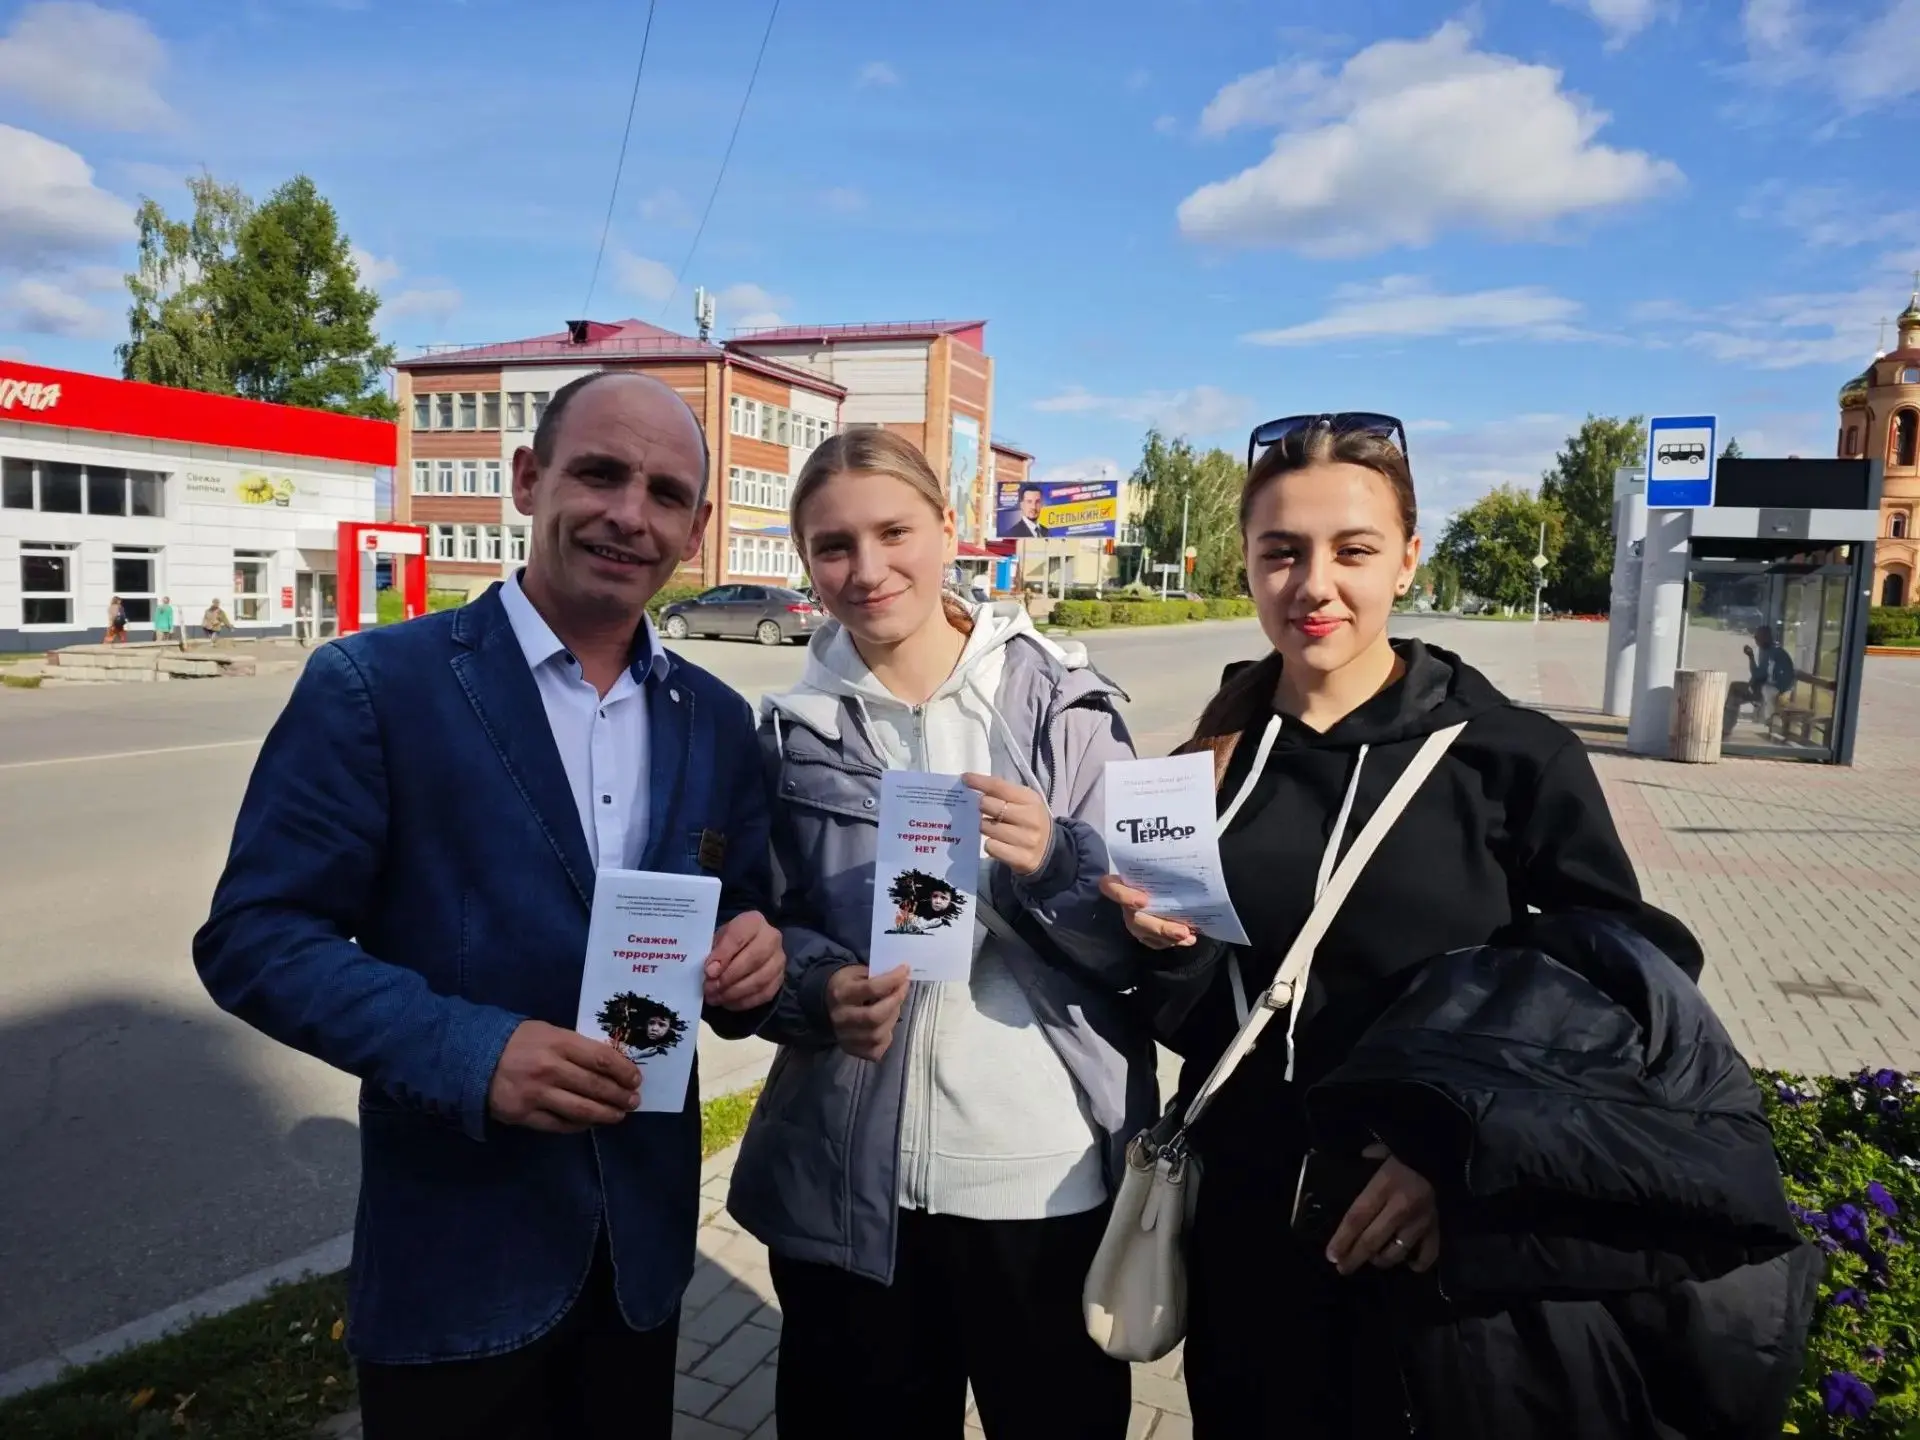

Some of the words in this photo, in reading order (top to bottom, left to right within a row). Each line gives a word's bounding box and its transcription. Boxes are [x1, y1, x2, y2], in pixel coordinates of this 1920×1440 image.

[908, 819, 952, 830] Скажем
[896, 832, 961, 845] терроризму
[914, 845, 937, 854] НЕТ
[627, 934, 678, 945] Скажем
[612, 950, 688, 962] терроризму
[632, 964, 658, 974] НЕТ
